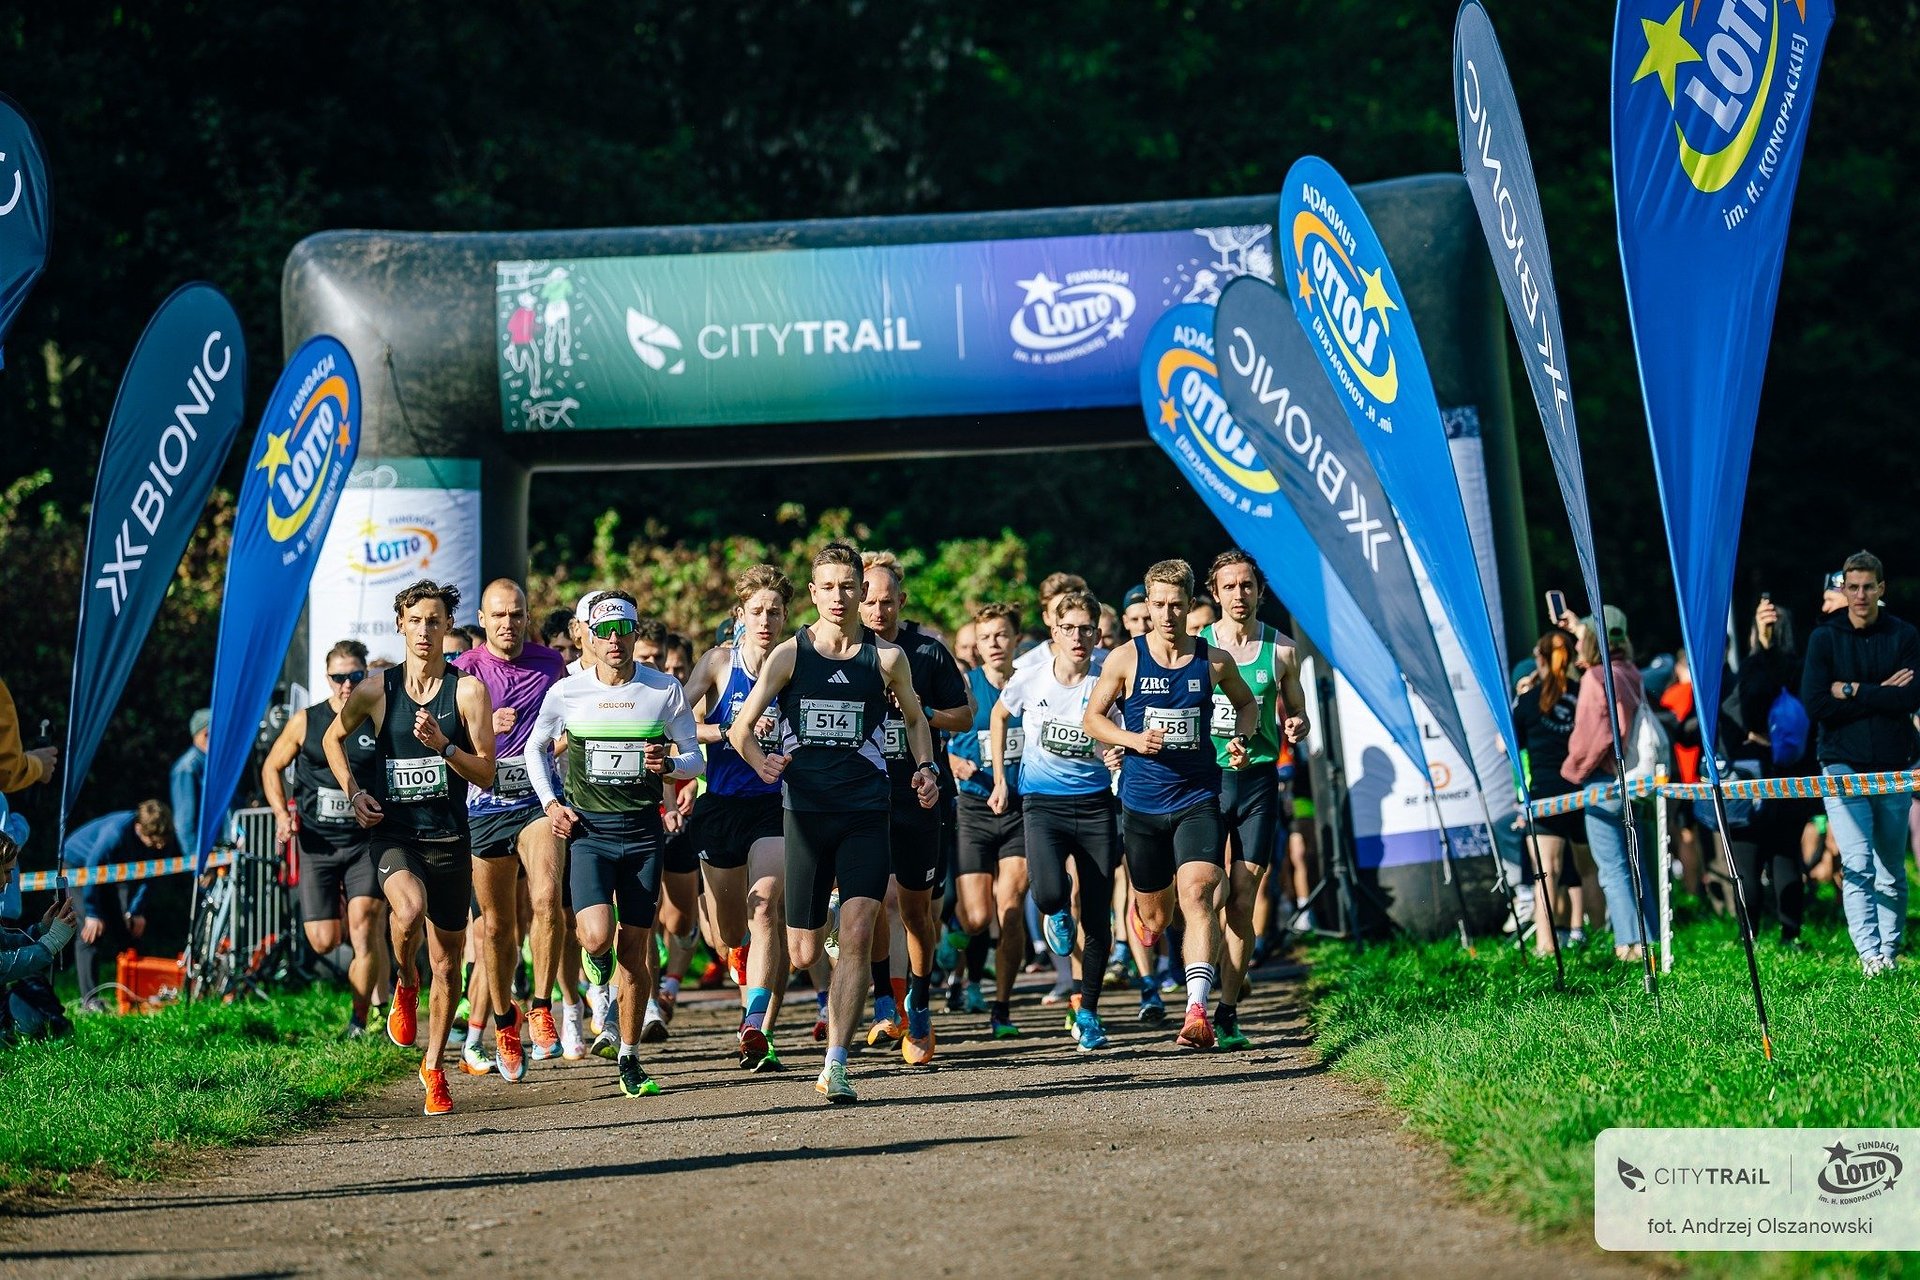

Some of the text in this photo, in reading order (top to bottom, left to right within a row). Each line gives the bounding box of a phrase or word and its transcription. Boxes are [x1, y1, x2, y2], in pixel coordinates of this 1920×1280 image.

[1723, 33, 1809, 230] im. H. KONOPACKIEJ
[1065, 269, 1129, 286] FUNDACJA
[1034, 294, 1113, 335] LOTTO
[289, 353, 336, 421] FUNDACJA
[277, 401, 334, 511] LOTTO
[365, 536, 421, 563] LOTTO
[1140, 677, 1170, 690] ZRC
[816, 713, 849, 729] 514
[1159, 721, 1187, 735] 158
[1051, 727, 1089, 743] 1095
[611, 754, 622, 768] 7
[396, 770, 436, 786] 1100
